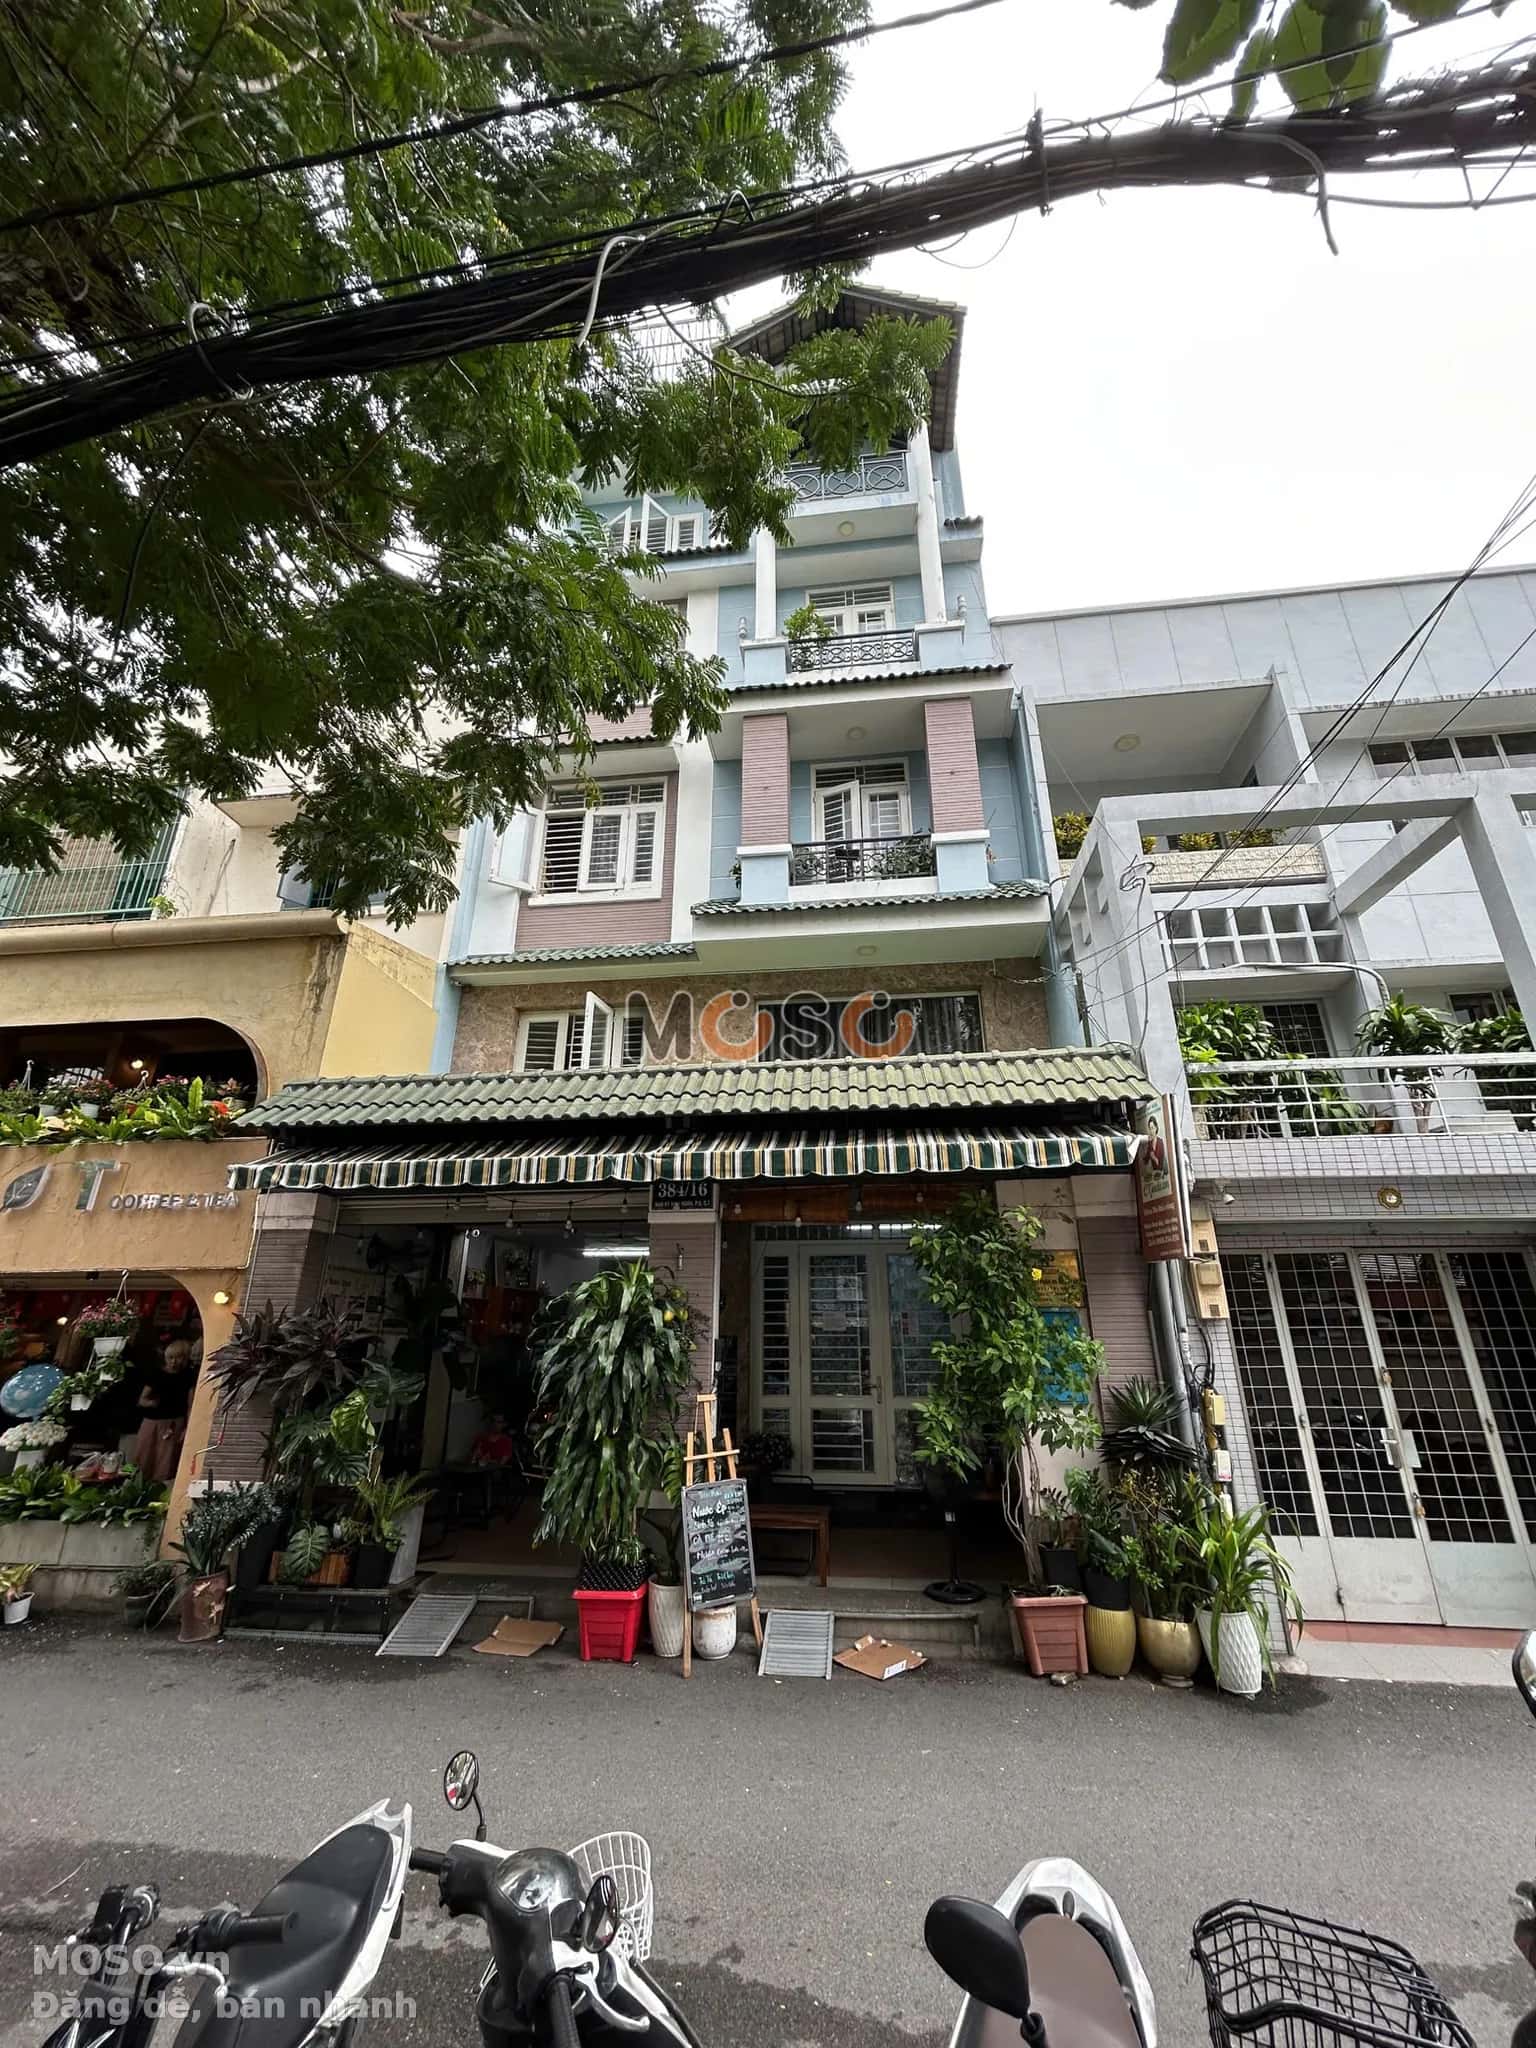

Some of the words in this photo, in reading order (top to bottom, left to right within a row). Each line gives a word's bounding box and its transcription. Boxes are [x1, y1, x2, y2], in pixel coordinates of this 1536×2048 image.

[658, 1182, 708, 1198] 384/16
[111, 1194, 181, 1209] COFFEE
[186, 1194, 199, 1208] &
[204, 1192, 239, 1208] TEA
